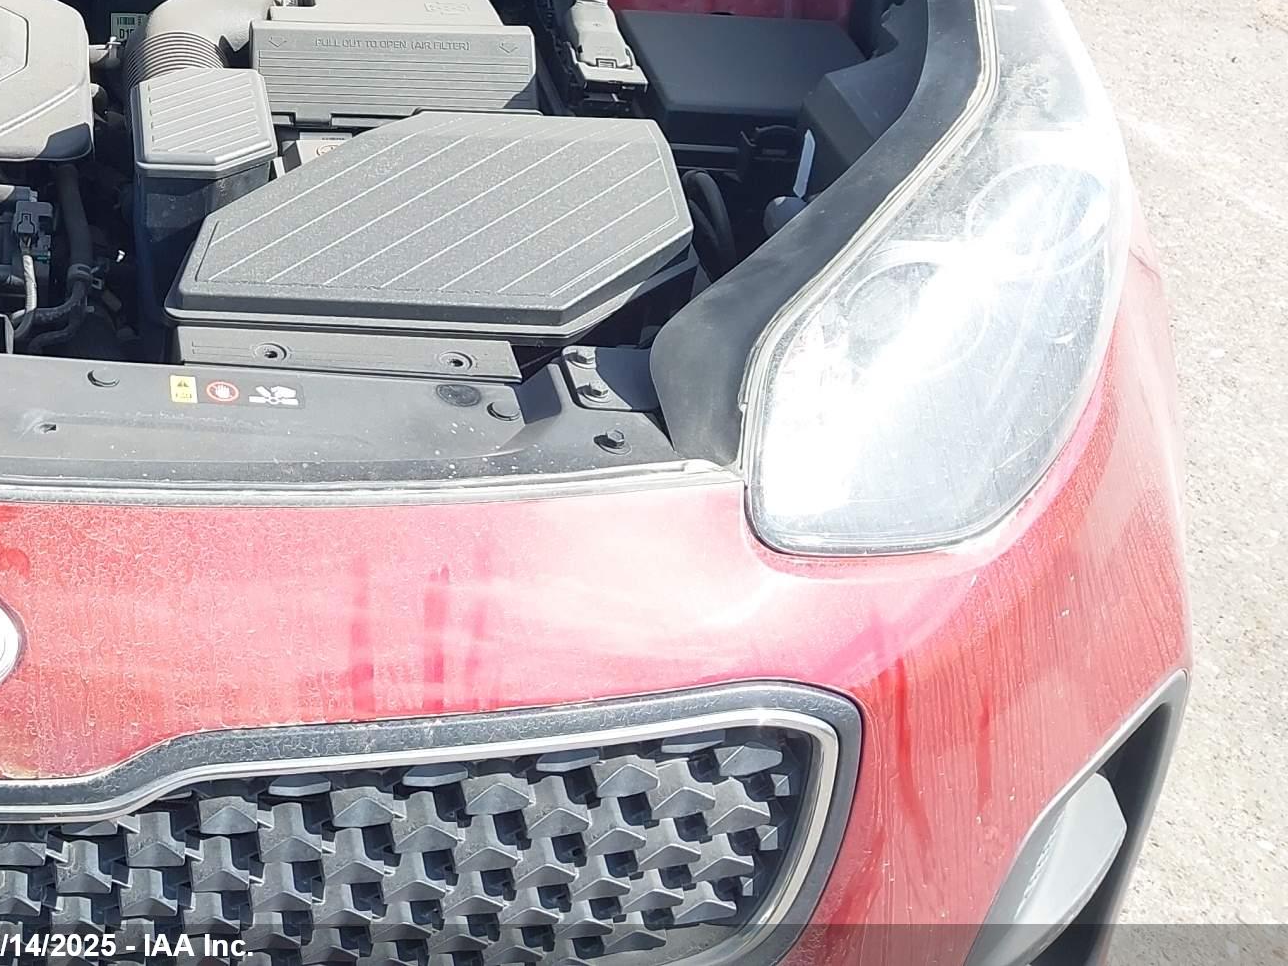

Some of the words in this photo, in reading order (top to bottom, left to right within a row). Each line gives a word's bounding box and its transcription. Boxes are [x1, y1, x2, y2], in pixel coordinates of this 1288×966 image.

[315, 38, 340, 47] PULL
[342, 39, 361, 48] OUT
[365, 40, 378, 48] TO
[379, 40, 407, 49] OPEN
[433, 41, 470, 51] FILTER)
